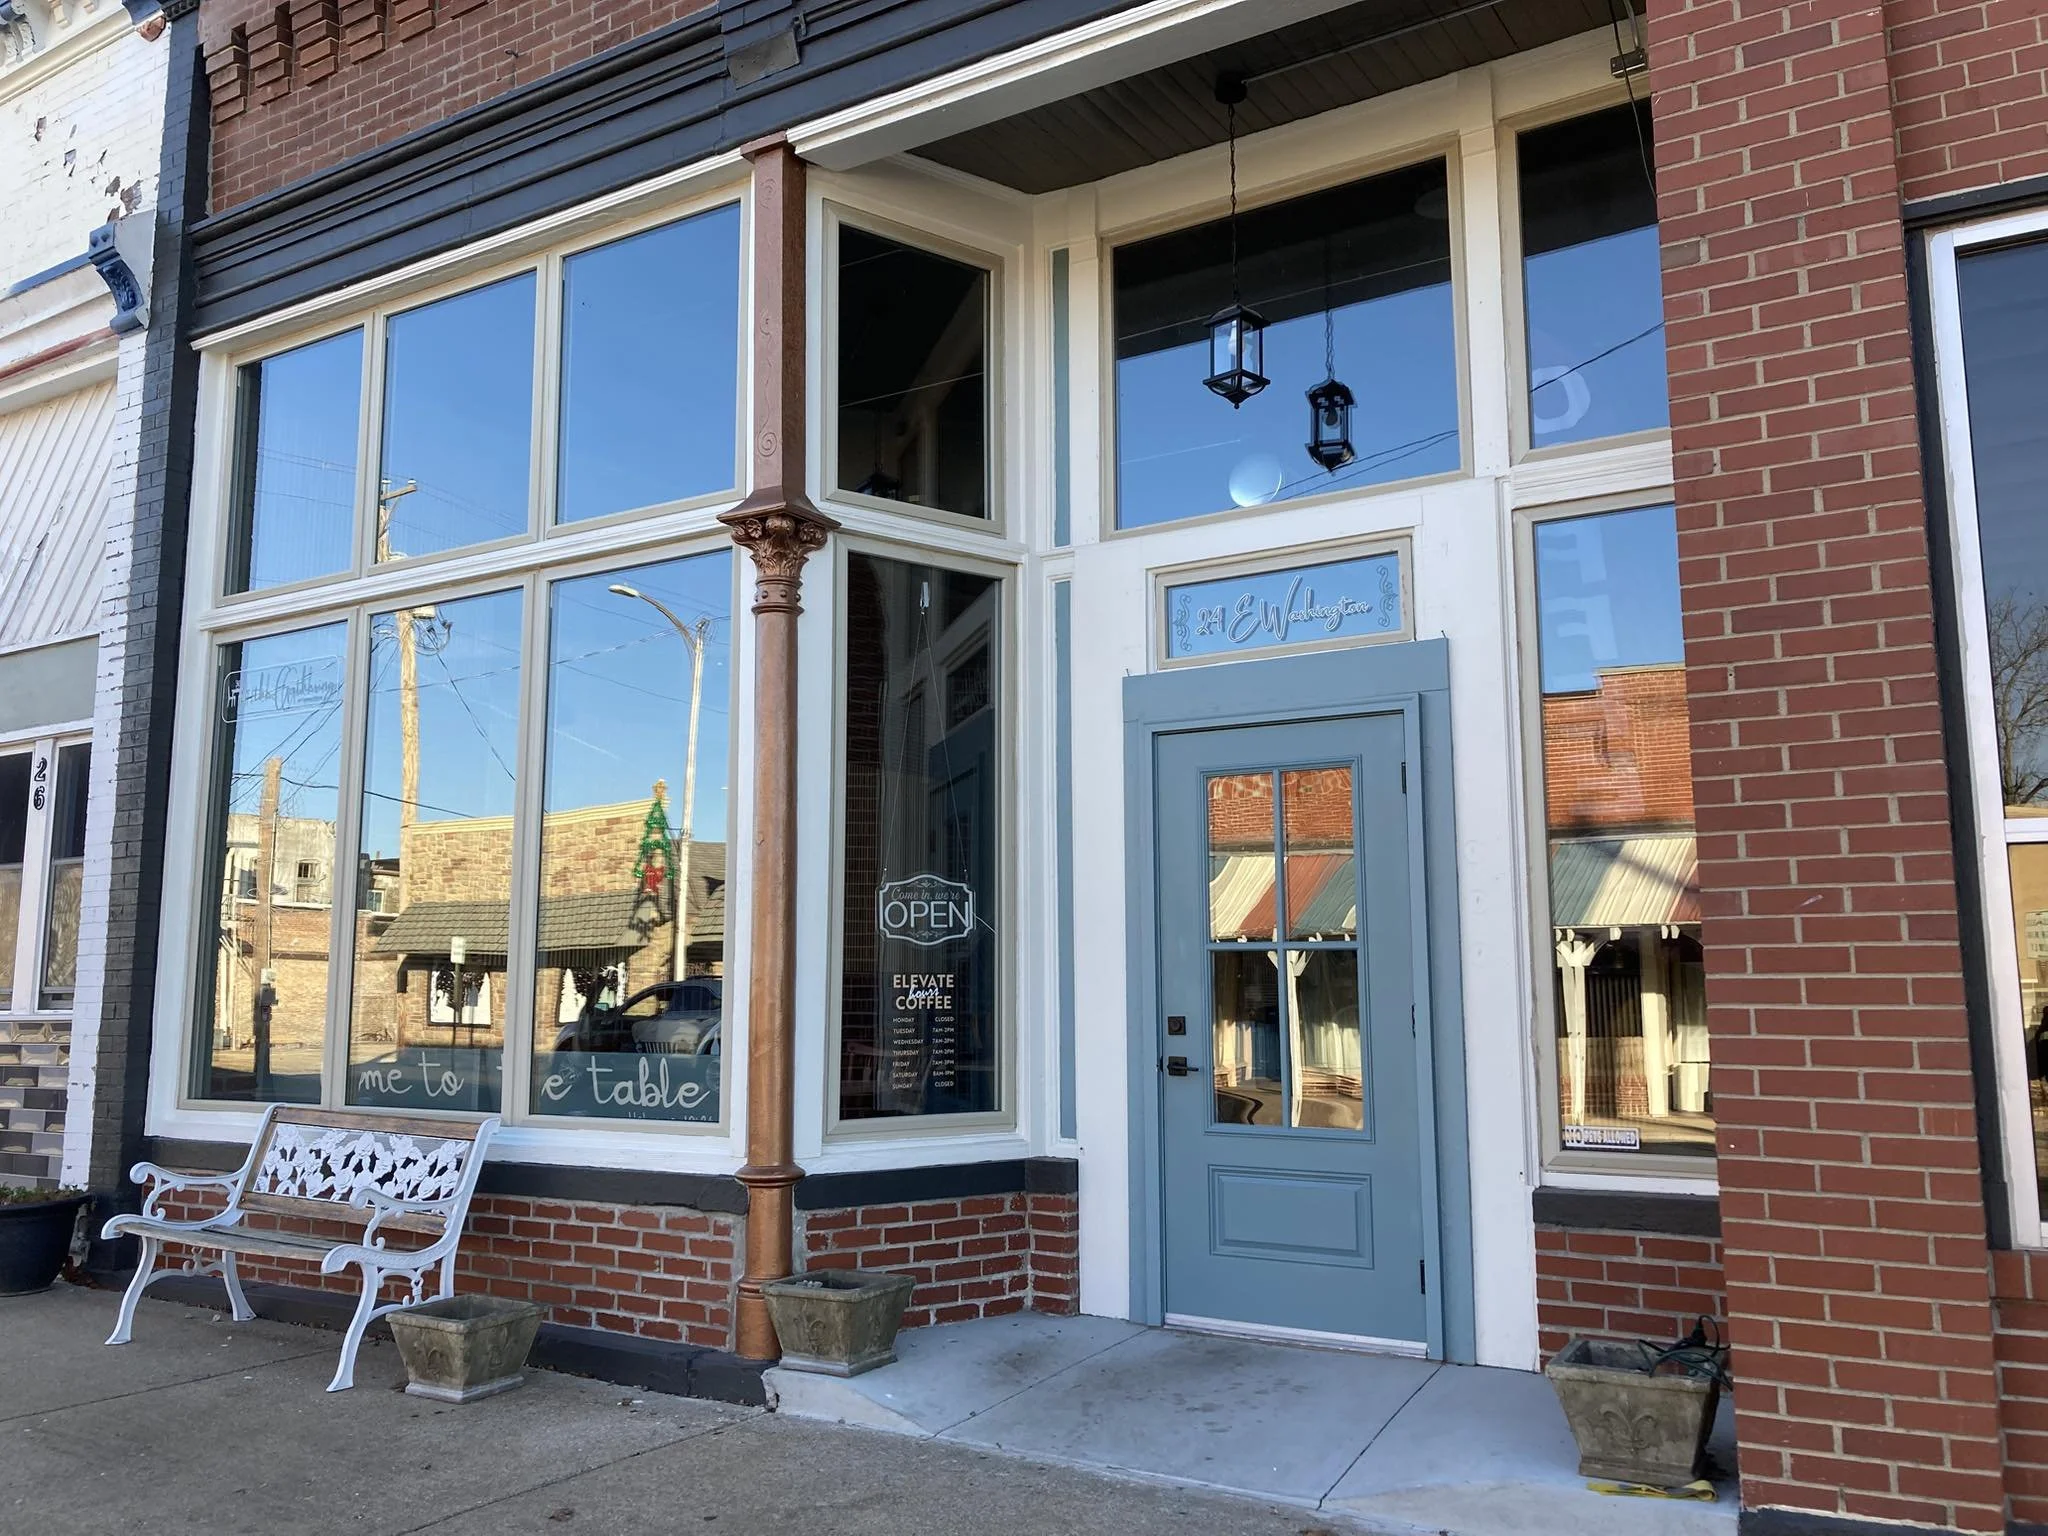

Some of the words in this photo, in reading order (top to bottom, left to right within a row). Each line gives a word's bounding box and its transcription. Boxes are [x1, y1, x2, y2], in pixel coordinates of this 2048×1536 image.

[1195, 606, 1224, 635] 24
[1227, 593, 1258, 642] E
[1259, 576, 1371, 640] Washington
[891, 887, 920, 901] Come
[884, 901, 969, 928] OPEN
[893, 974, 954, 988] ELEVATE
[909, 984, 940, 999] hours
[895, 995, 952, 1010] COFFEE
[418, 1052, 464, 1097] to
[586, 1055, 711, 1109] table
